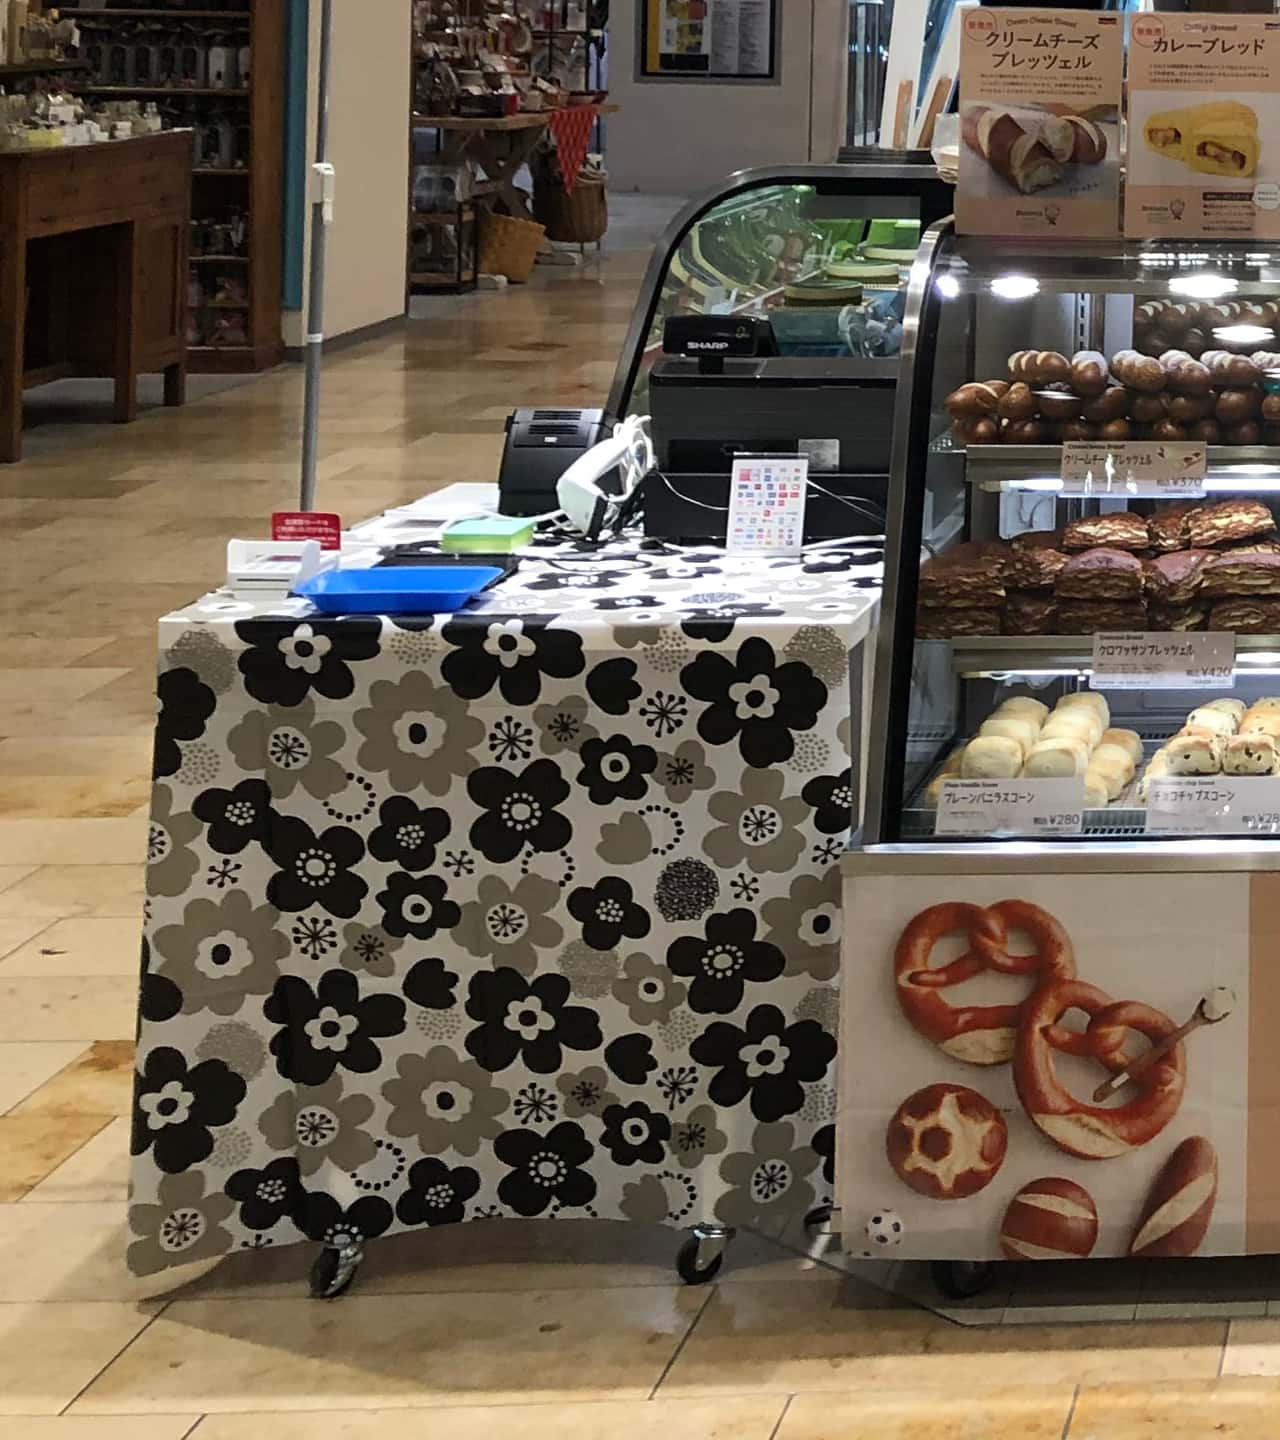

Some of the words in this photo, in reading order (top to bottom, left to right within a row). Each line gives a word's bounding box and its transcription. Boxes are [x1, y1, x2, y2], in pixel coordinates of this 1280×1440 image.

[986, 31, 1100, 49] クリームチーズ
[1153, 38, 1265, 55] カレーブレッド
[992, 52, 1092, 70] ブレッツェル
[686, 341, 729, 351] SHARP
[1200, 666, 1231, 677] ¥420
[1049, 814, 1079, 826] ¥280
